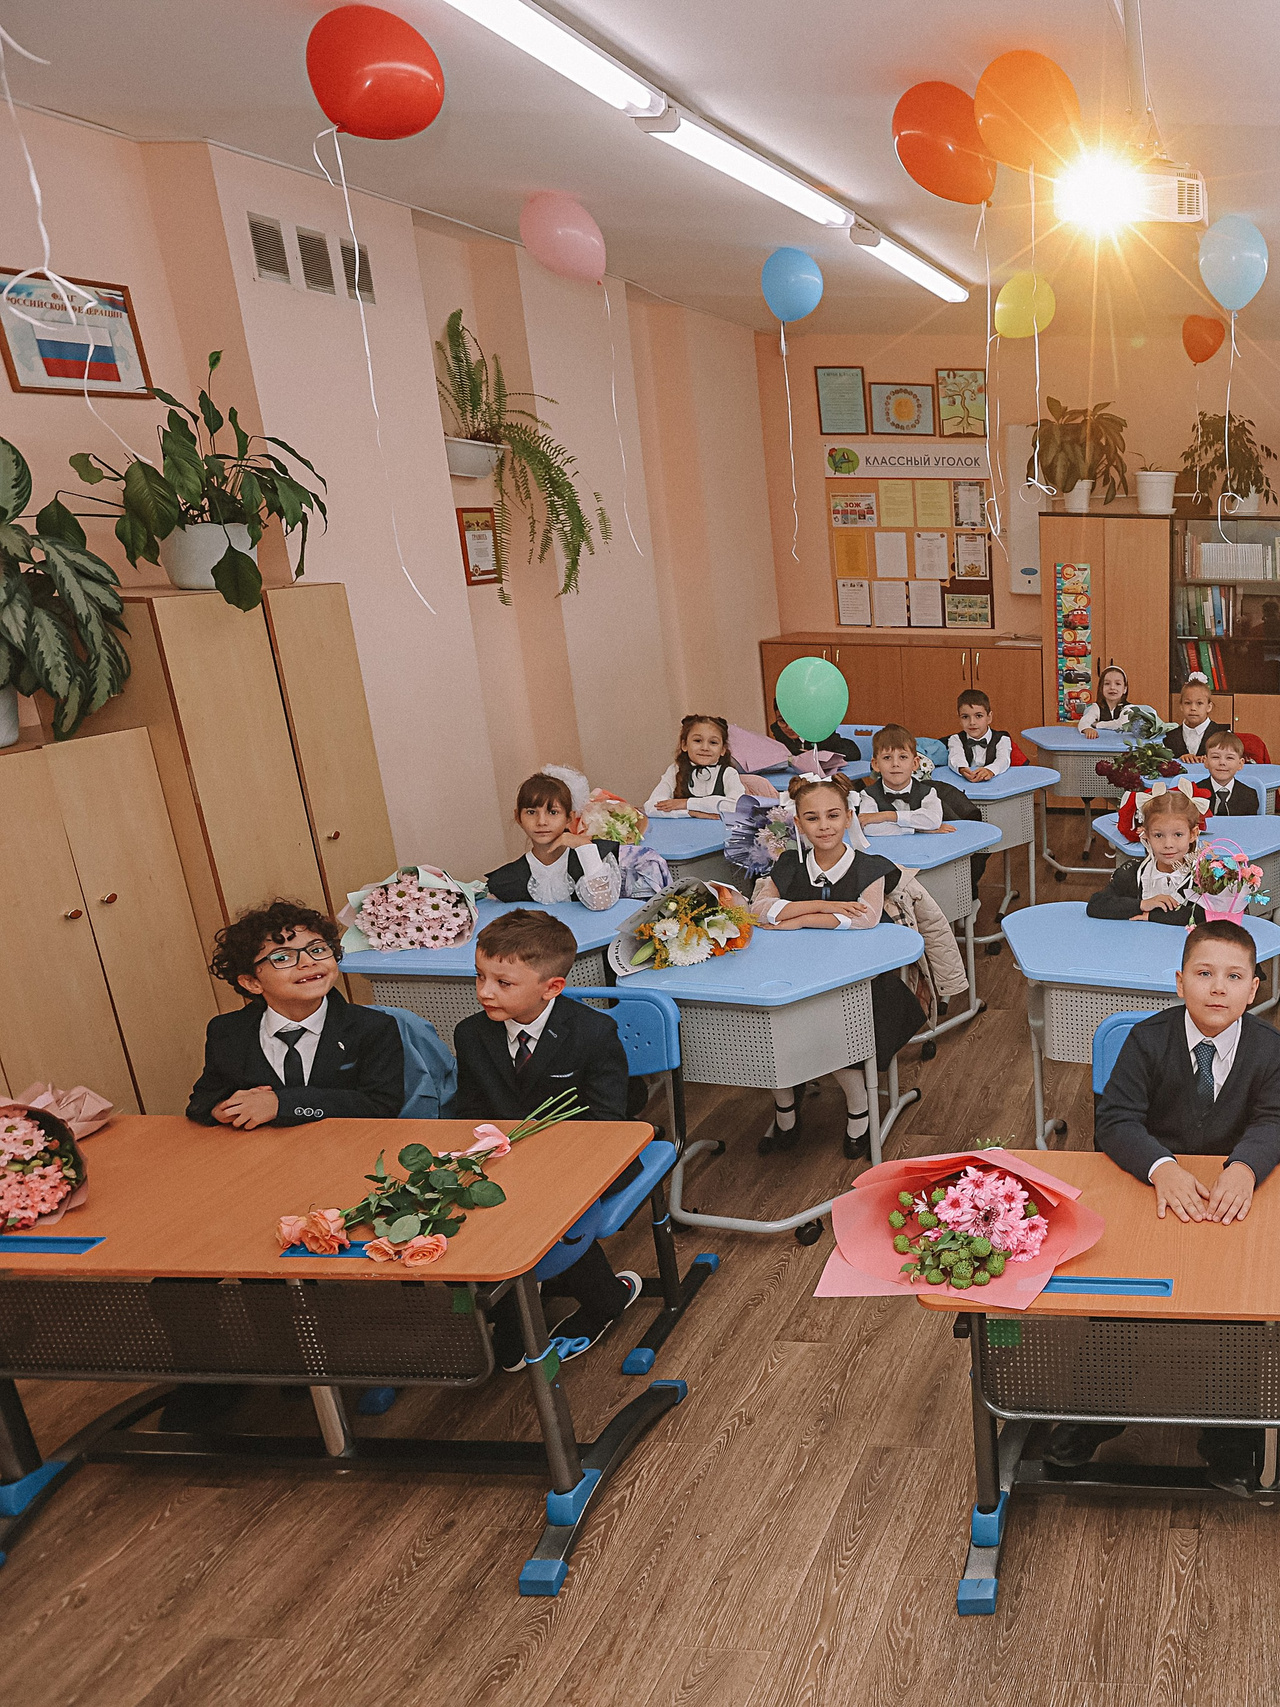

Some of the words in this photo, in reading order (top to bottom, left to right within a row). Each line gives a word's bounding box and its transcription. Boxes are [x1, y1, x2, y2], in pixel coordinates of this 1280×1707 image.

[51, 292, 77, 302] ФАГ
[865, 454, 931, 466] КЛАССНЫЙ
[934, 456, 981, 467] УГОЛОК
